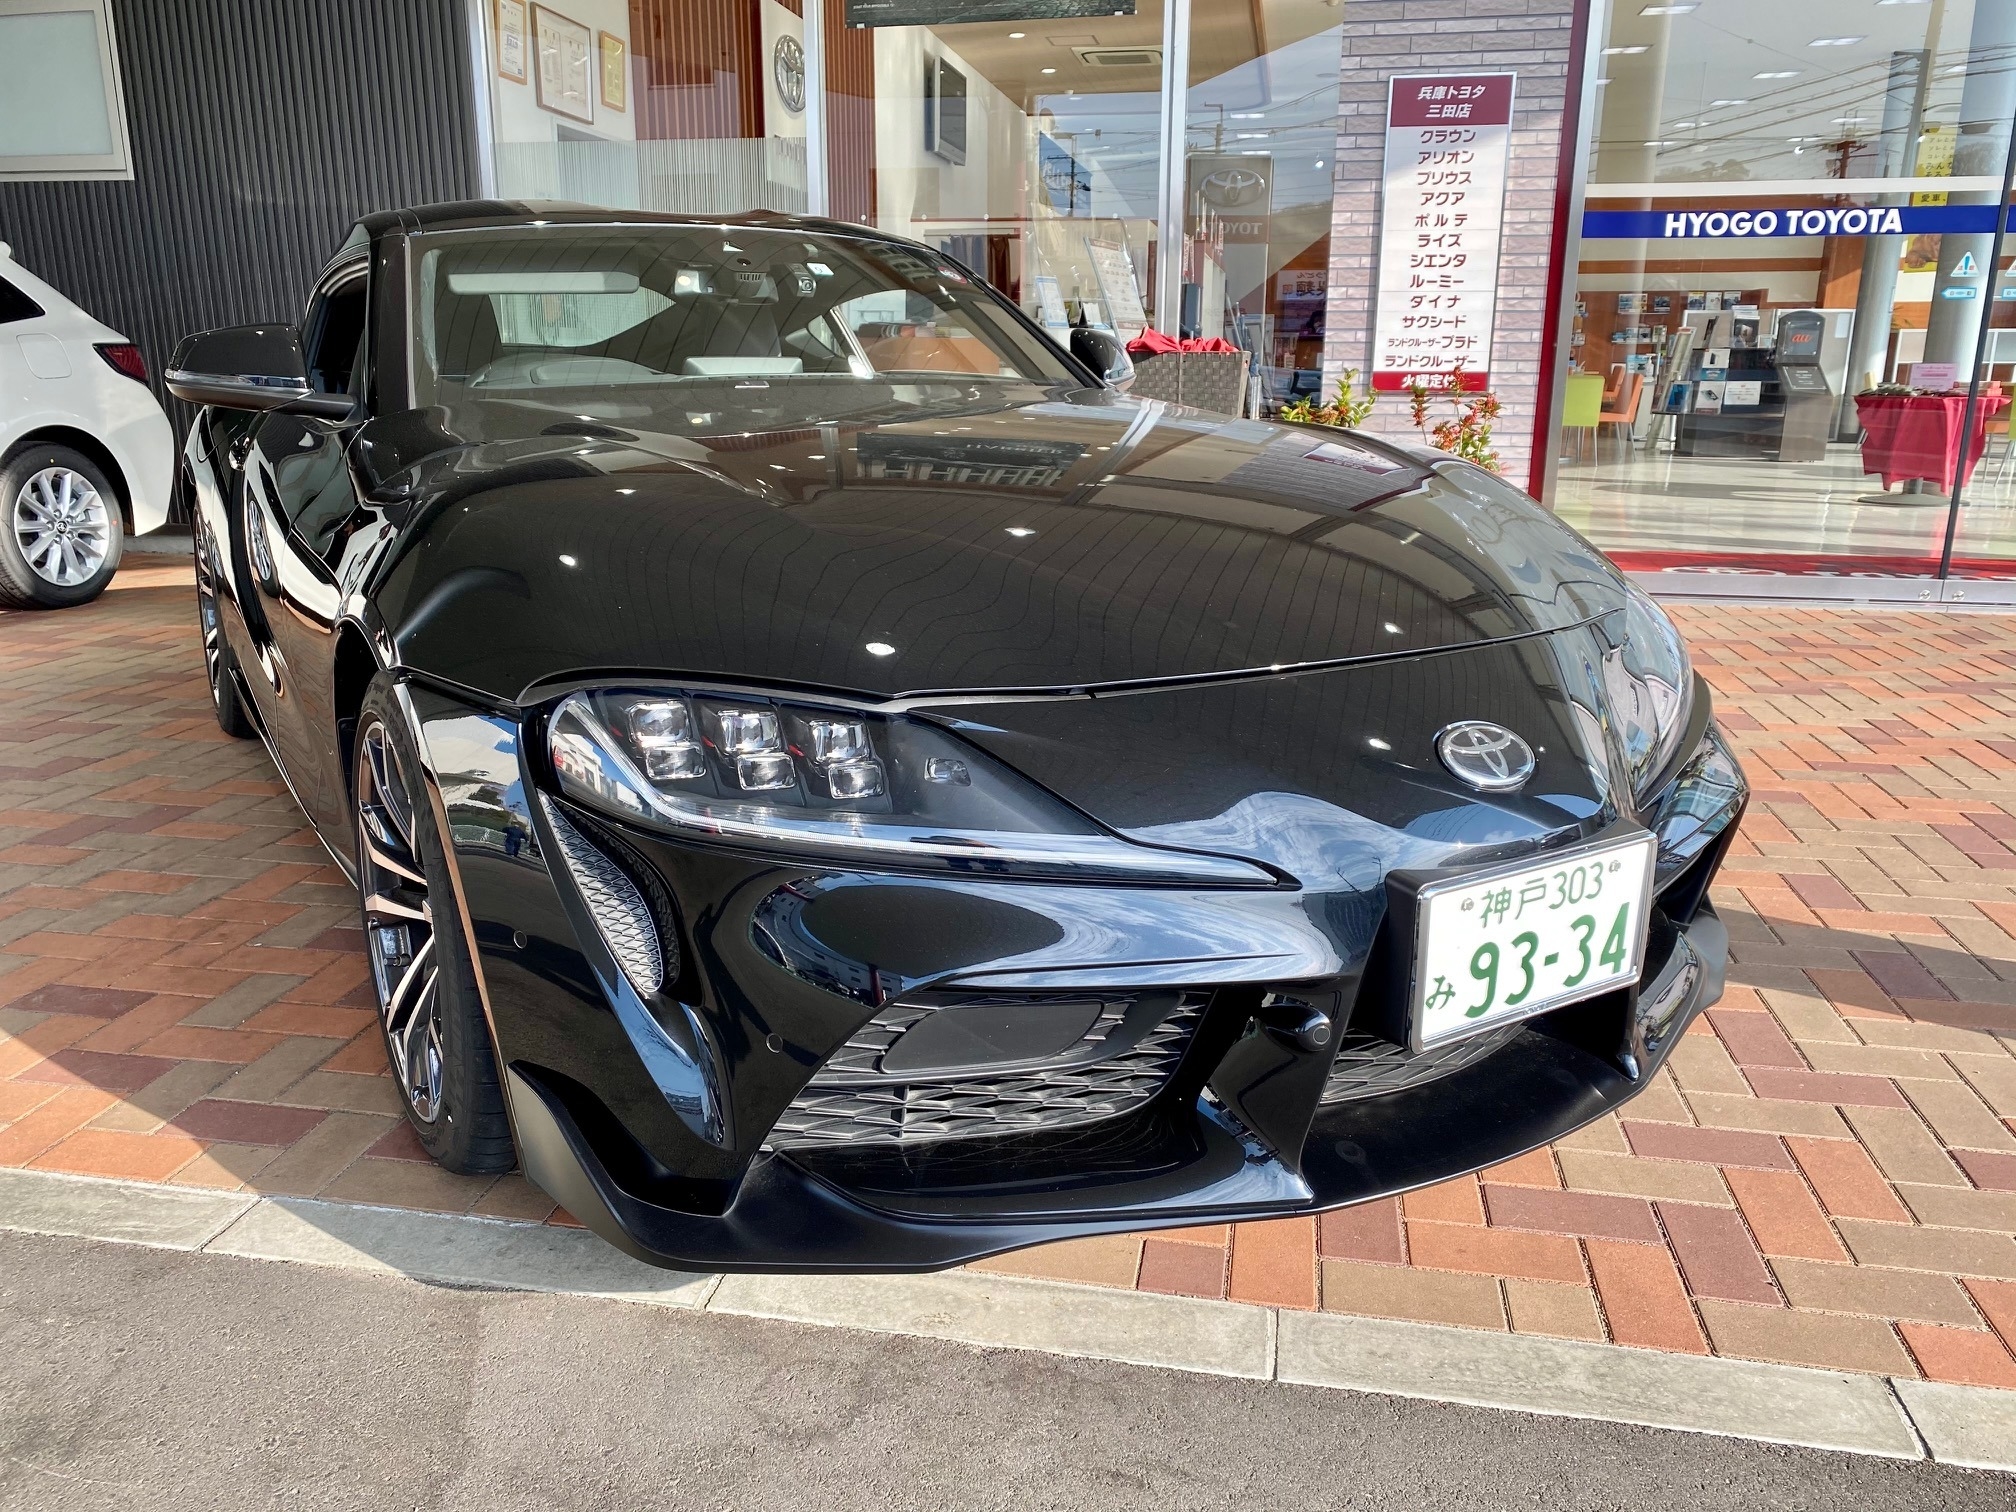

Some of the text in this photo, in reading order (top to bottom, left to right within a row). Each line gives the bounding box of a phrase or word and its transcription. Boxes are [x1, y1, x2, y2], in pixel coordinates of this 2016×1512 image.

[1417, 85, 1486, 100] 兵庫トヨタ
[1425, 103, 1473, 118] 三田店
[1420, 129, 1476, 144] クラウン
[1418, 150, 1474, 165] アリオン
[1417, 171, 1472, 186] プリウス
[1420, 192, 1465, 206] アクア
[1414, 213, 1468, 227] ポルテ
[1664, 208, 1903, 237] HYOGO TOYOTA
[1418, 233, 1462, 247] ライズ
[1411, 254, 1467, 268] シエンタ
[1409, 274, 1464, 288] ルーミー
[1410, 295, 1461, 308] ダイナ
[1402, 315, 1467, 328] サクシード
[1388, 335, 1478, 349] ランドクルーザープラド
[1791, 333, 1812, 343] au
[1385, 355, 1477, 367] ランドクルーザー
[1425, 902, 1630, 1018] み 93-34
